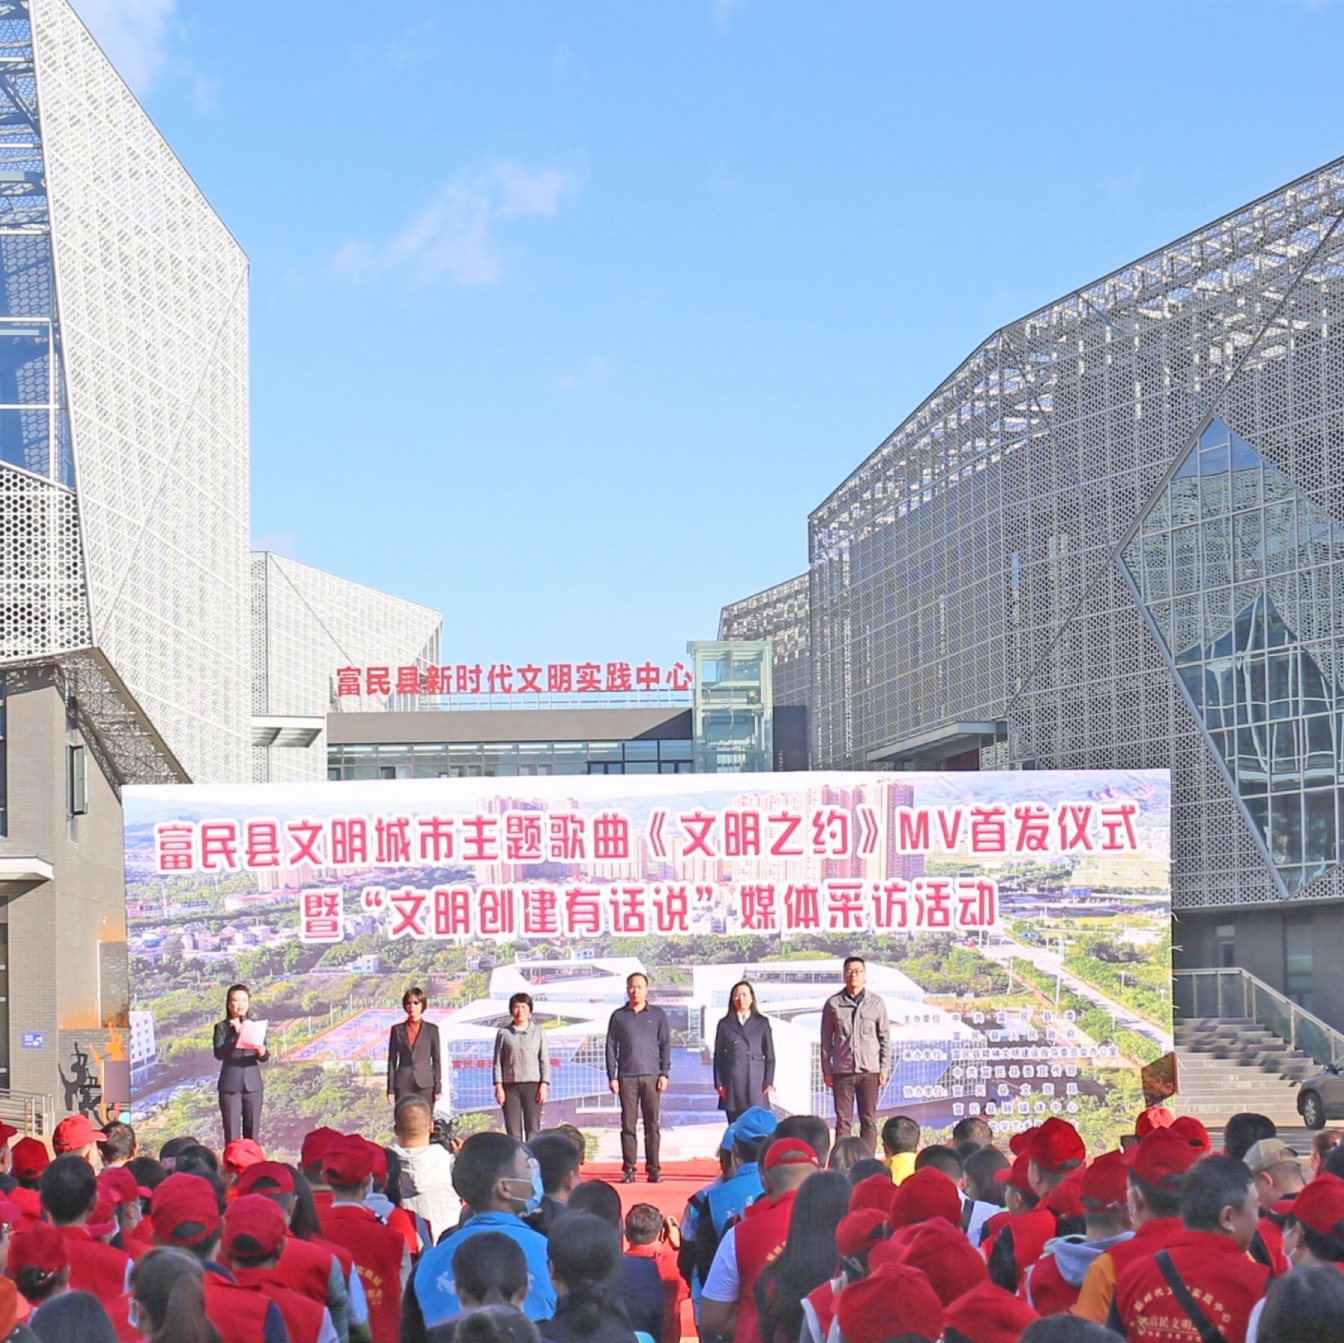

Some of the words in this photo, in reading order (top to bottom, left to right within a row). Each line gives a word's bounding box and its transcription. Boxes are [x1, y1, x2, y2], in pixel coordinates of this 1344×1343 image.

[336, 662, 693, 697] 富民县新时代文明实践中心
[157, 804, 1140, 870] 富民县文明城市主题歌曲《文明之约》MV首发仪式
[303, 880, 996, 938] 暨“文明创建有话说”媒体采访活动
